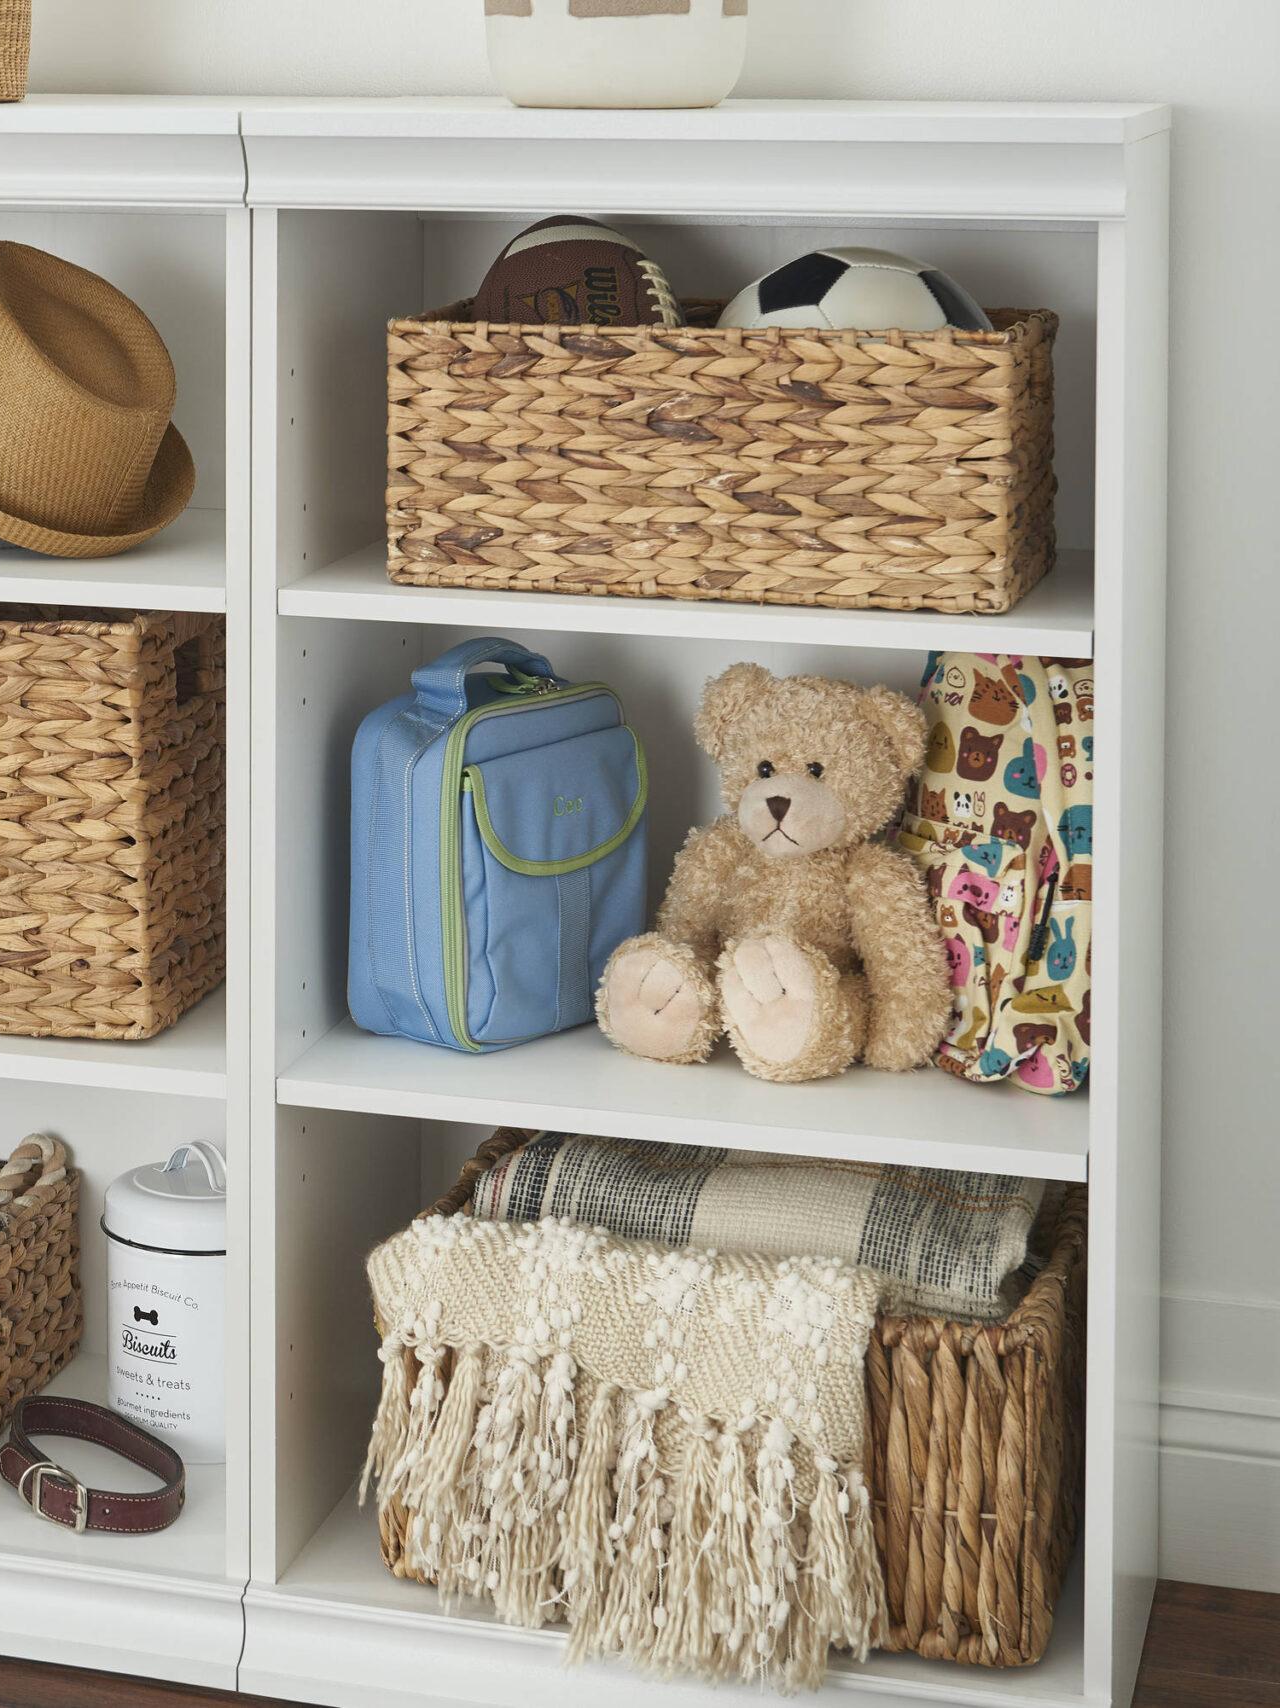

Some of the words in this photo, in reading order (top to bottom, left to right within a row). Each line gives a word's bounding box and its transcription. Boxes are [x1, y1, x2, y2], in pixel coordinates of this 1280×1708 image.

[583, 266, 620, 326] Wils
[123, 1279, 149, 1292] Appetit
[151, 1284, 182, 1303] Biscuit
[183, 1296, 199, 1311] Co.
[122, 1329, 177, 1360] Biscuits
[146, 1373, 155, 1386] &
[157, 1376, 191, 1391] treats
[143, 1406, 191, 1421] ingredients
